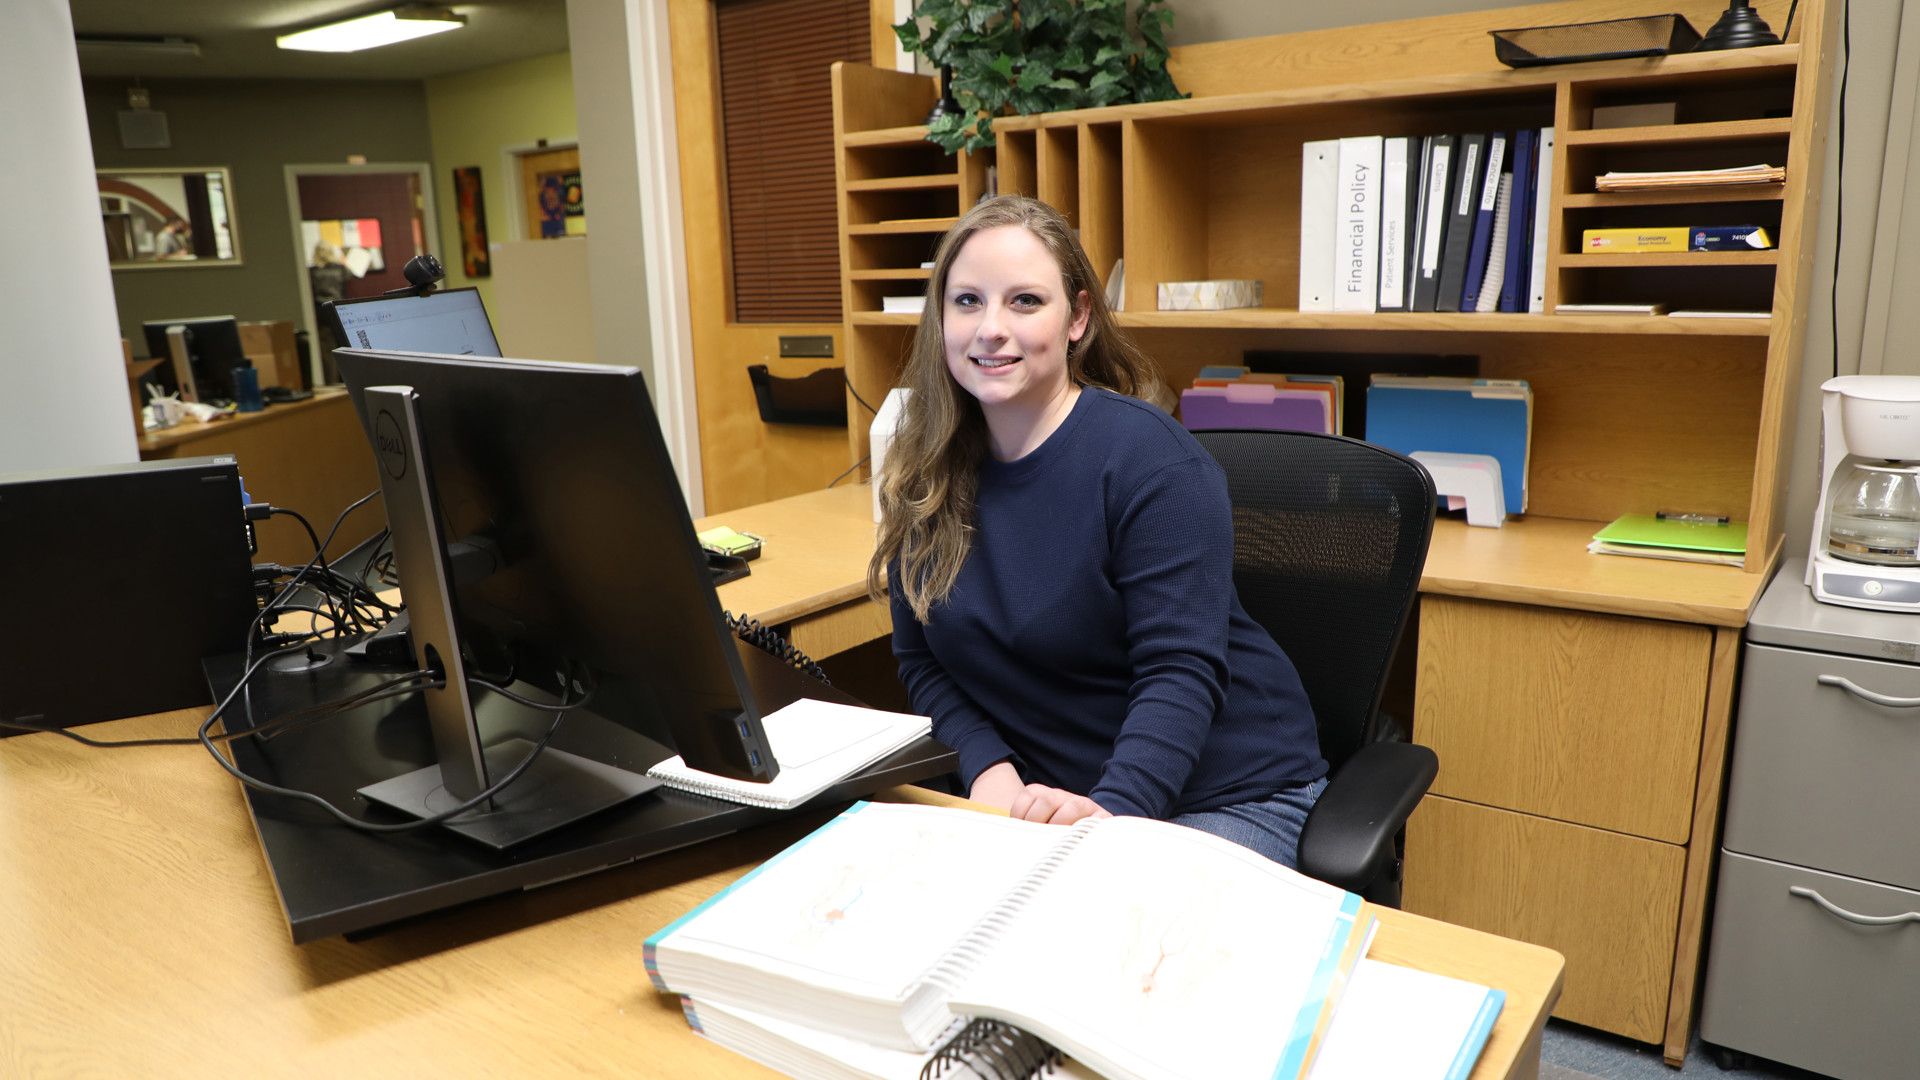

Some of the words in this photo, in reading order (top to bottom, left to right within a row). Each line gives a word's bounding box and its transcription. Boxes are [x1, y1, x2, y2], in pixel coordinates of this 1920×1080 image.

[1433, 163, 1445, 193] Claims
[1488, 140, 1503, 184] Insurance
[1351, 163, 1370, 214] Policy
[1484, 186, 1494, 204] Info
[1386, 221, 1396, 256] Services
[1347, 220, 1365, 293] Financial
[1385, 258, 1394, 289] Patient
[380, 436, 403, 455] DELL
